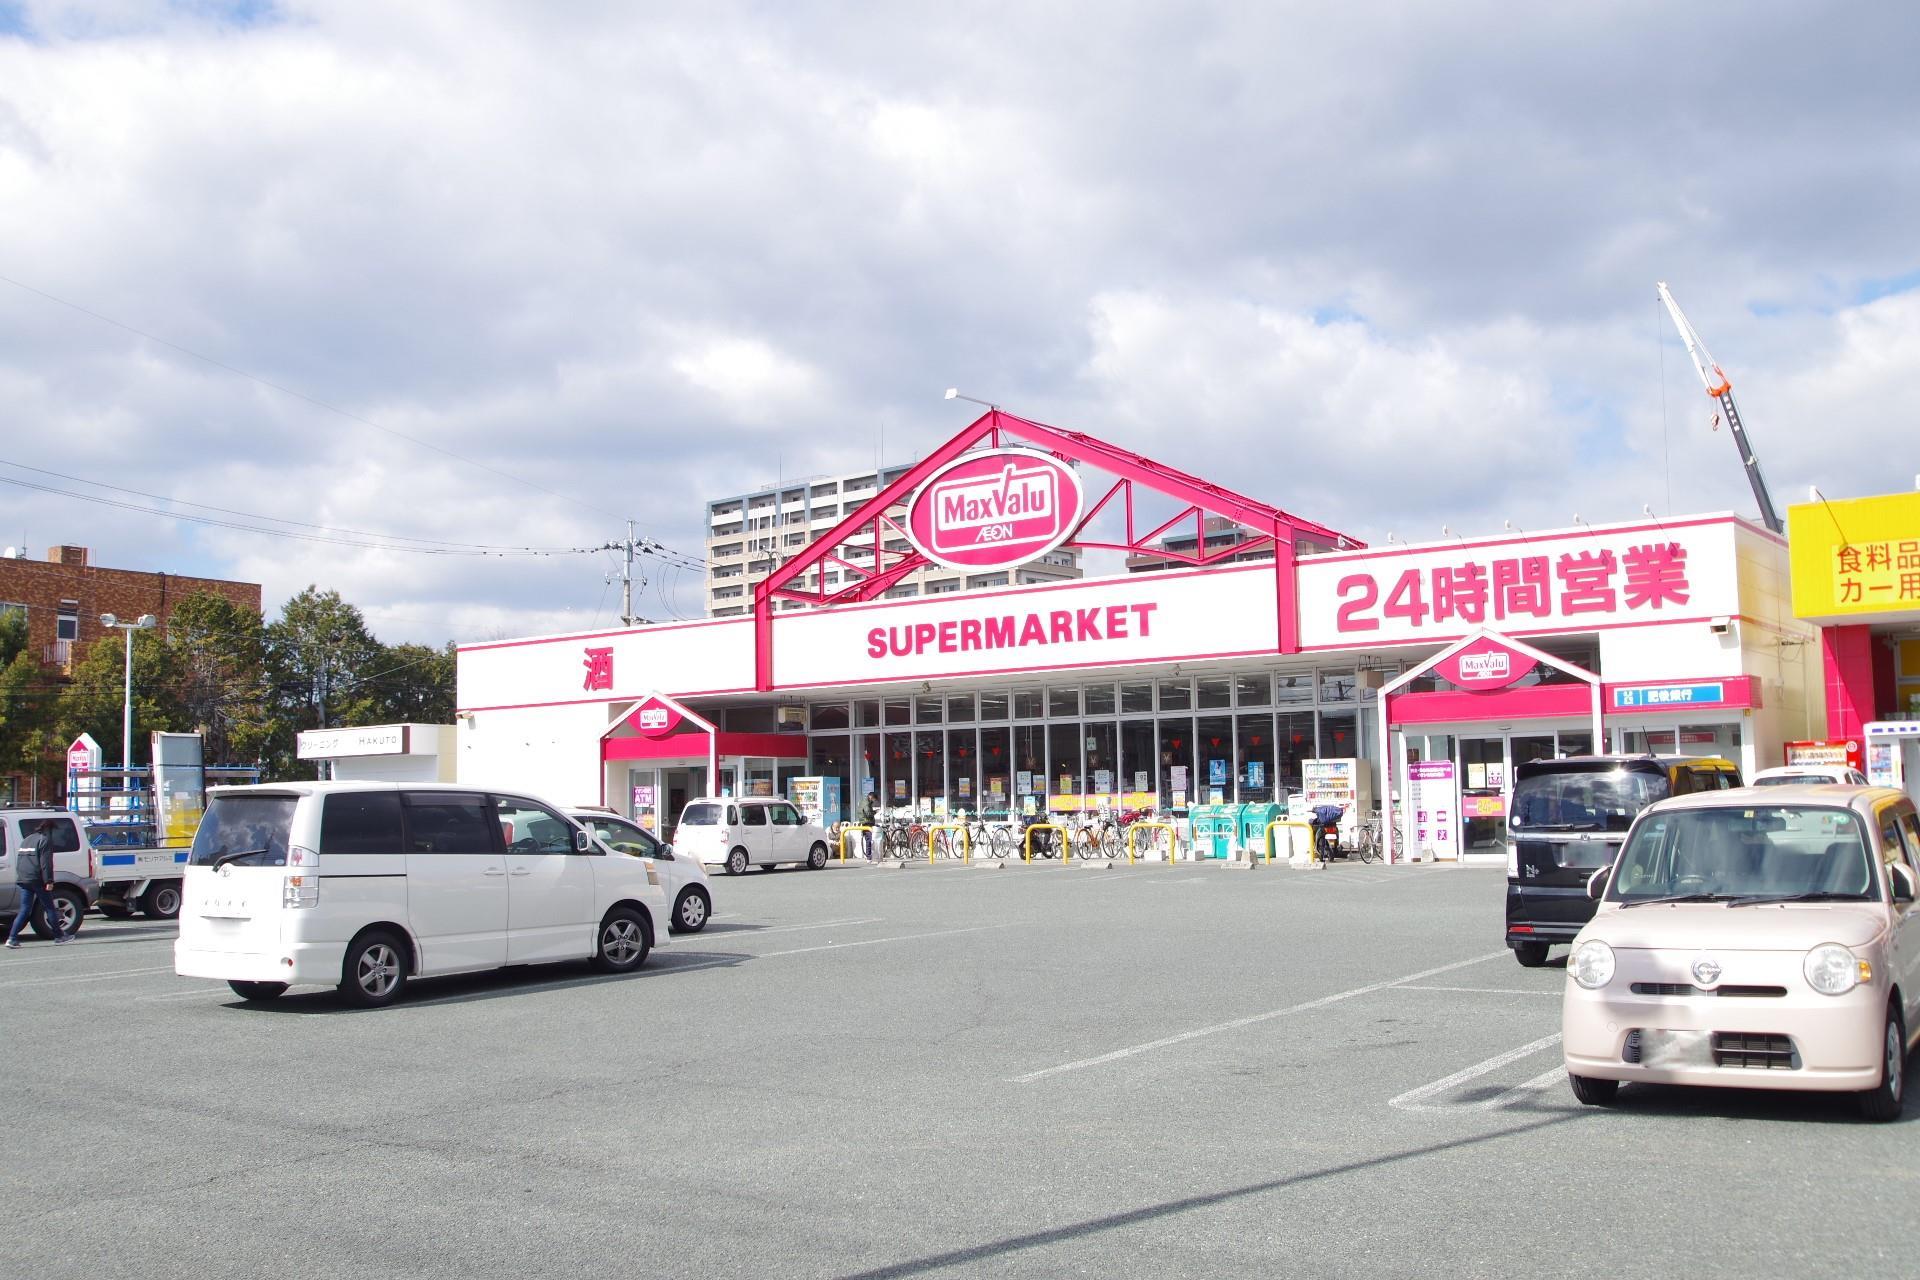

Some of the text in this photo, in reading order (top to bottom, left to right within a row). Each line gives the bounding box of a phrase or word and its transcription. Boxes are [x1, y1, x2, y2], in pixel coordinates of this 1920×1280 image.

[944, 467, 1045, 524] MaxValu
[1837, 542, 1920, 574] 食料品
[1336, 542, 1690, 633] 24時間営業
[867, 602, 1158, 659] SUPERMARKET
[583, 646, 614, 691] 酒
[1465, 653, 1504, 670] MaxValu
